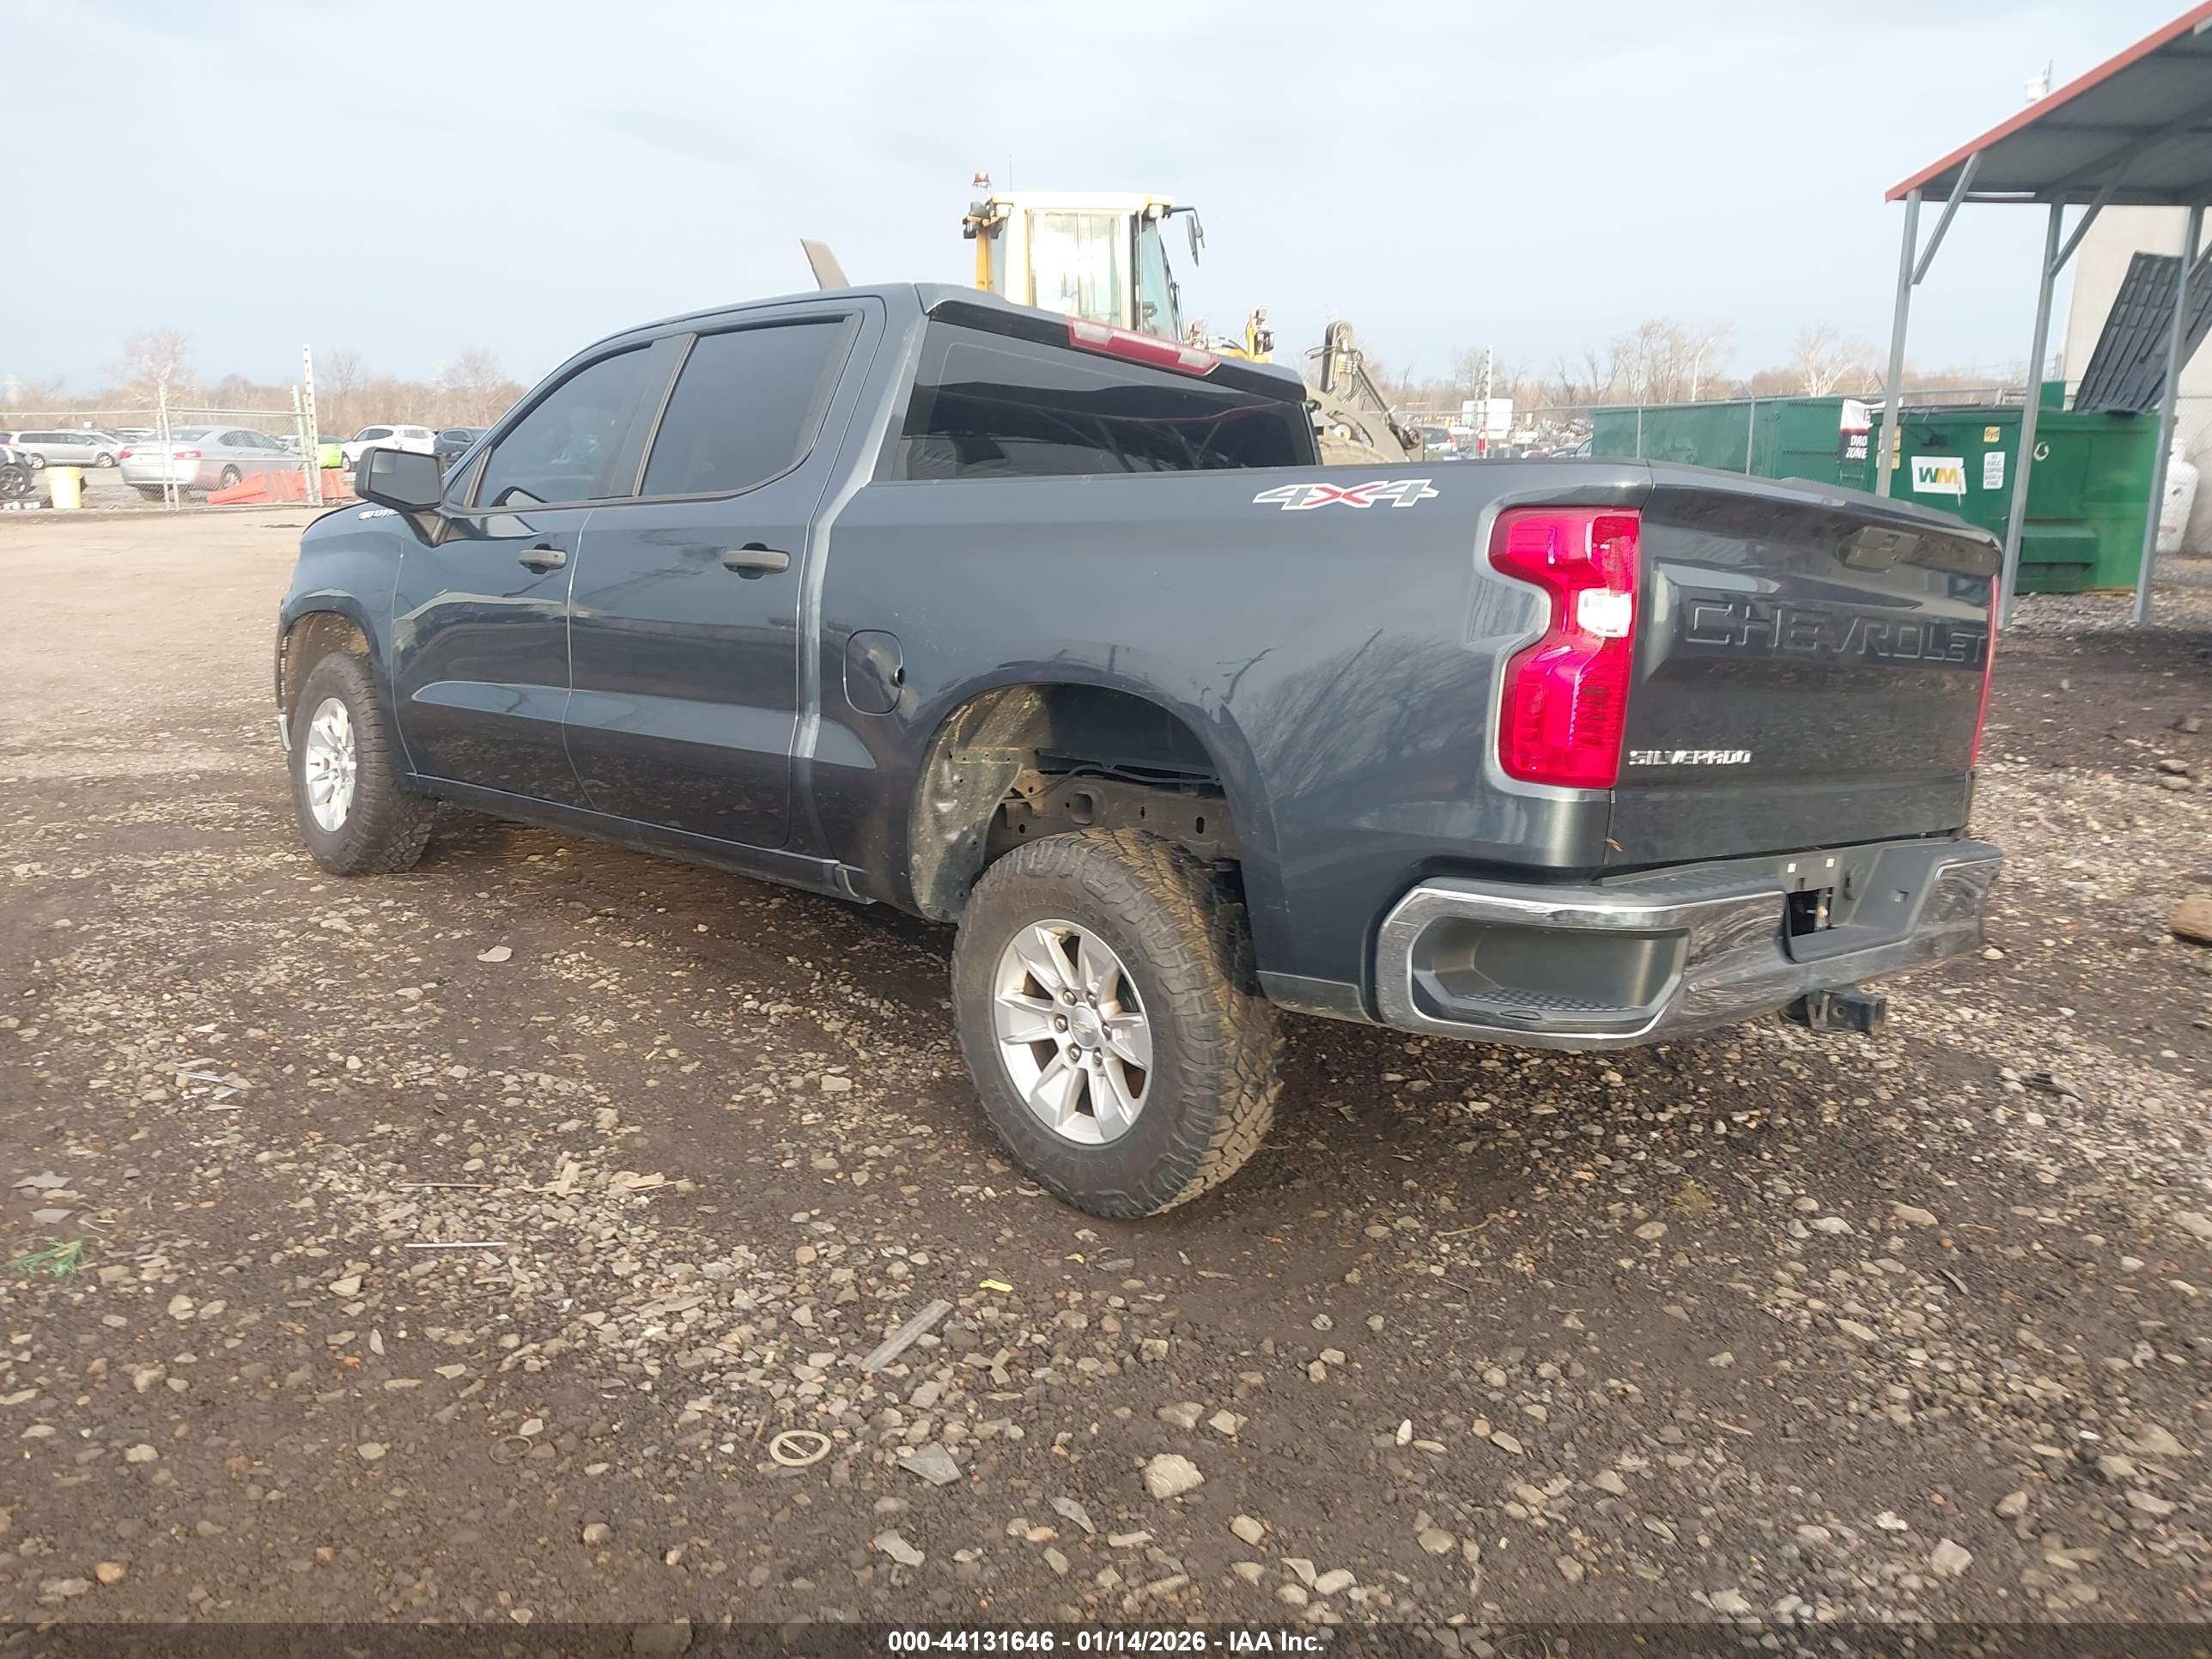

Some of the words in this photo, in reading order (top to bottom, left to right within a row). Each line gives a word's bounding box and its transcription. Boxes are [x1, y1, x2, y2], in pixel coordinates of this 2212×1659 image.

[1845, 447, 1869, 459] ZONE
[1918, 466, 1959, 485] WM
[1685, 599, 1987, 664] CHEVROLET
